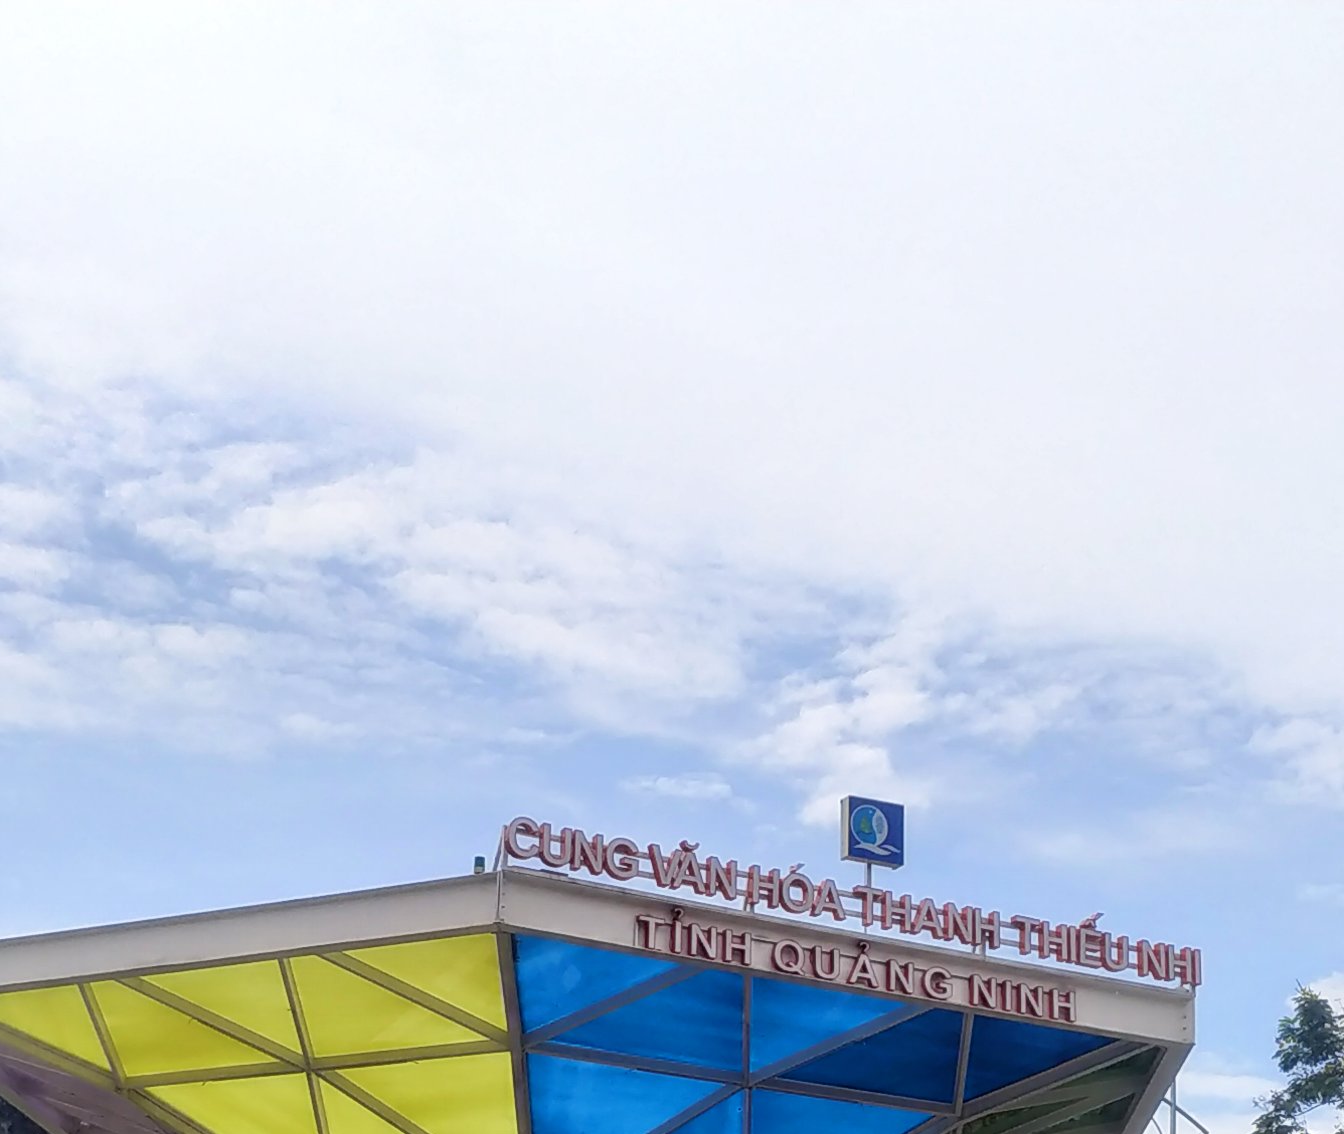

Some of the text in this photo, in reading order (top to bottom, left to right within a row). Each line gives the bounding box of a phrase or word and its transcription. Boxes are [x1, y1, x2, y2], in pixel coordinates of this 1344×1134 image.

[506, 816, 1202, 986] CUNG VĂN HÓA THANH THIẾU NHI
[638, 907, 1077, 1022] TỈNH QUẢNG NINH
